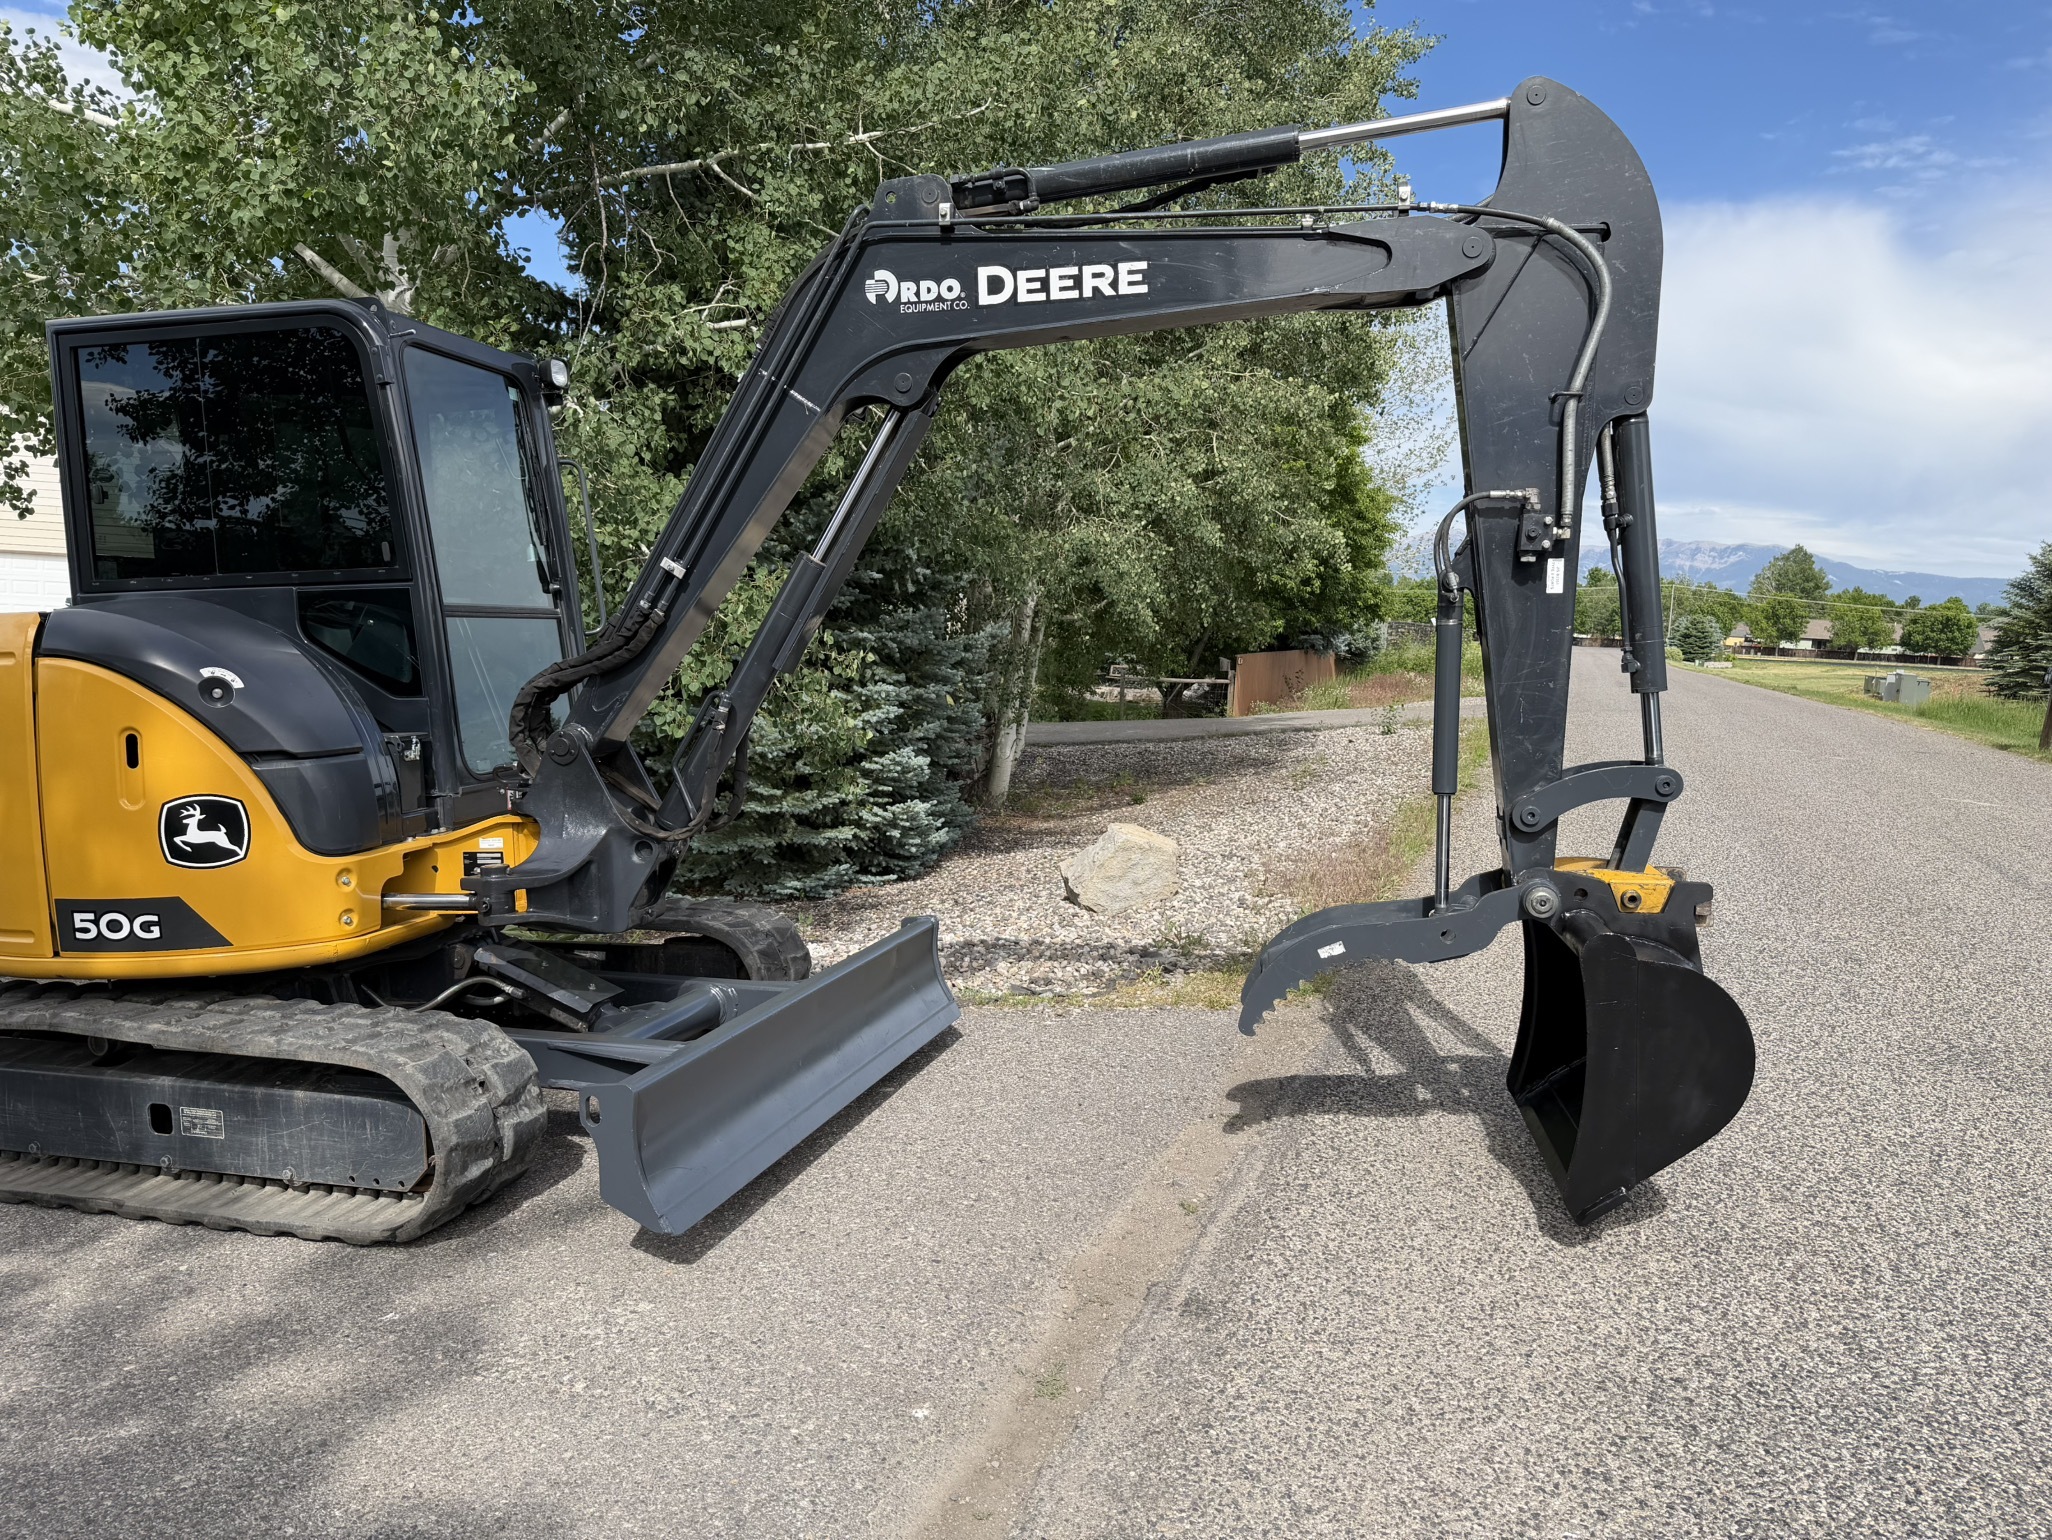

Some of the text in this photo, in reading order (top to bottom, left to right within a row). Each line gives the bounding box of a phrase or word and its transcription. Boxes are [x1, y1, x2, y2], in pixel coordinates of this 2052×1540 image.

[977, 261, 1149, 306] DEERE
[900, 300, 970, 314] EQUIPMENT CO.
[73, 912, 161, 940] 50G
